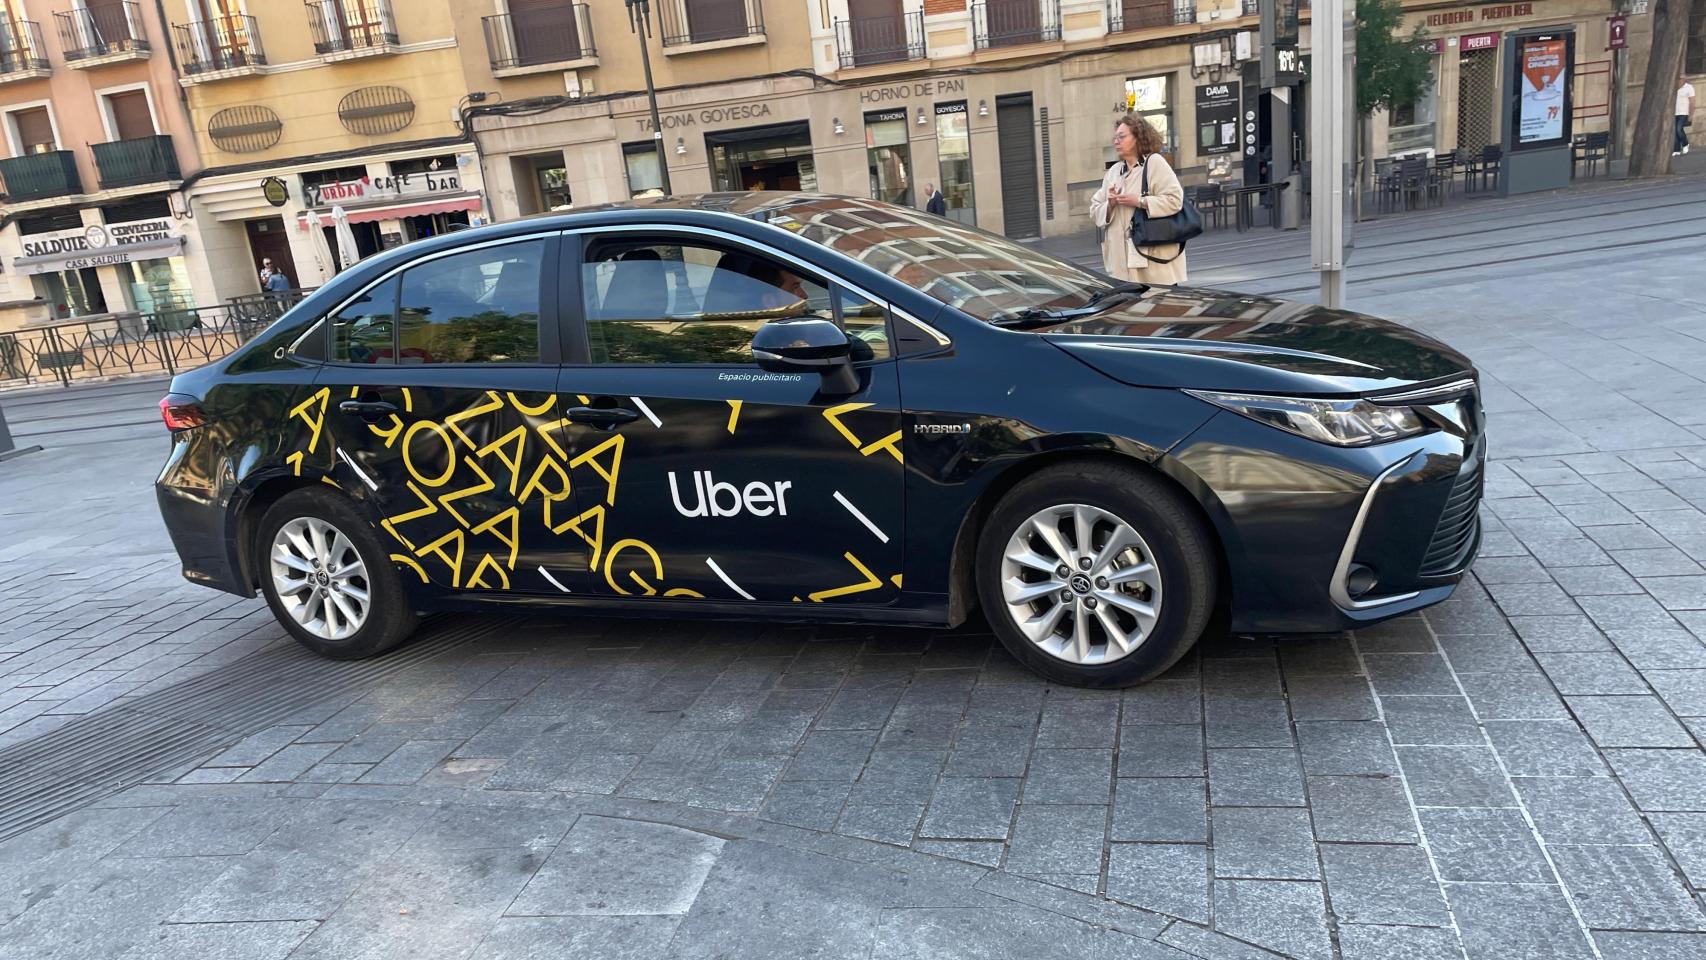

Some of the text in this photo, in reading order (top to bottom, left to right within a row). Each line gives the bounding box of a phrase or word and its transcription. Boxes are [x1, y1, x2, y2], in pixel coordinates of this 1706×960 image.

[1482, 5, 1512, 20] PUERTA
[1467, 36, 1491, 48] PUERTA
[860, 79, 964, 104] HORNO DE PAN
[700, 104, 771, 124] GOYESCA
[879, 112, 905, 121] TAHONA
[936, 105, 965, 114] GOYESCA
[111, 221, 170, 237] CERVECERIA
[24, 235, 88, 257] SALDUIE
[65, 253, 129, 269] CASA SALDUIE
[718, 372, 801, 383] Espacio publicitario
[914, 424, 961, 433] HYBRID
[668, 470, 791, 517] Uber
